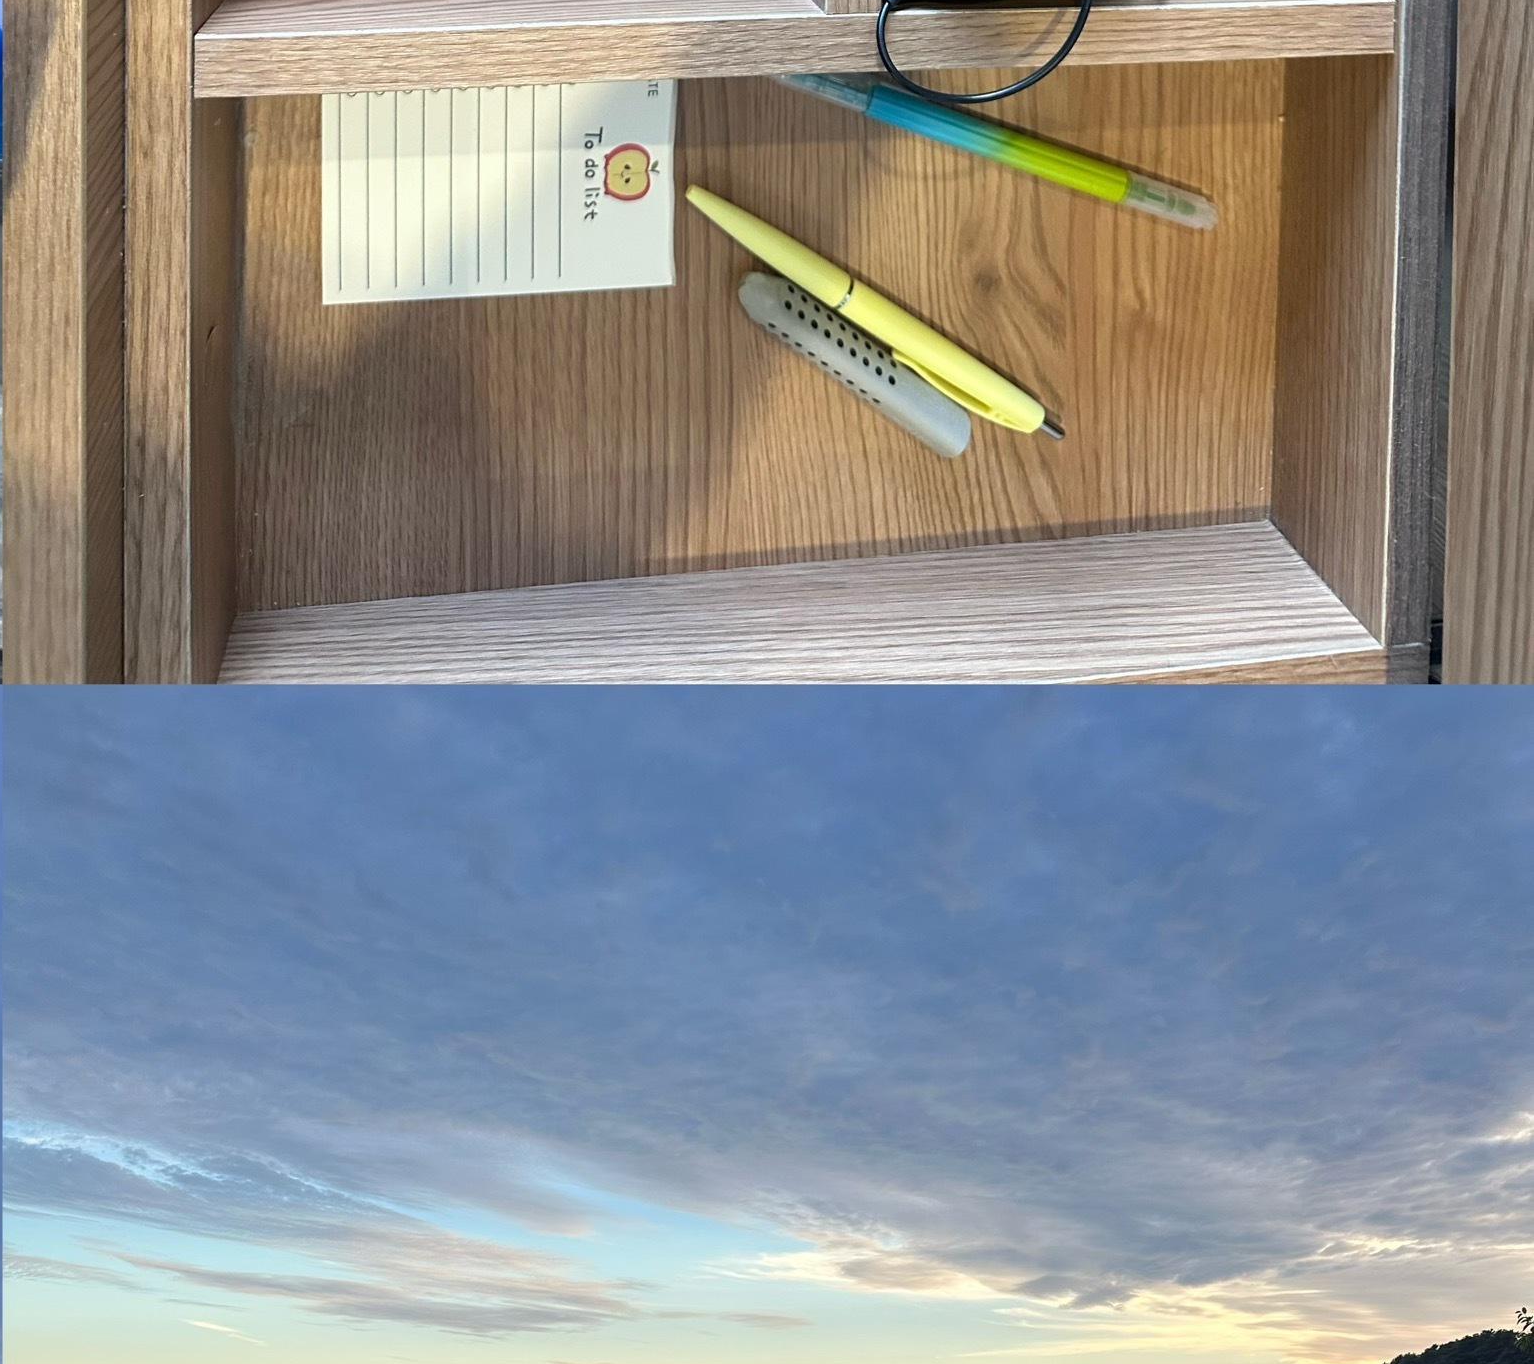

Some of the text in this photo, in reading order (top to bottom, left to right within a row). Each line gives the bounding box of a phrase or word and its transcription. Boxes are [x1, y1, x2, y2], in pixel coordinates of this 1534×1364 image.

[583, 126, 604, 222] To do list
